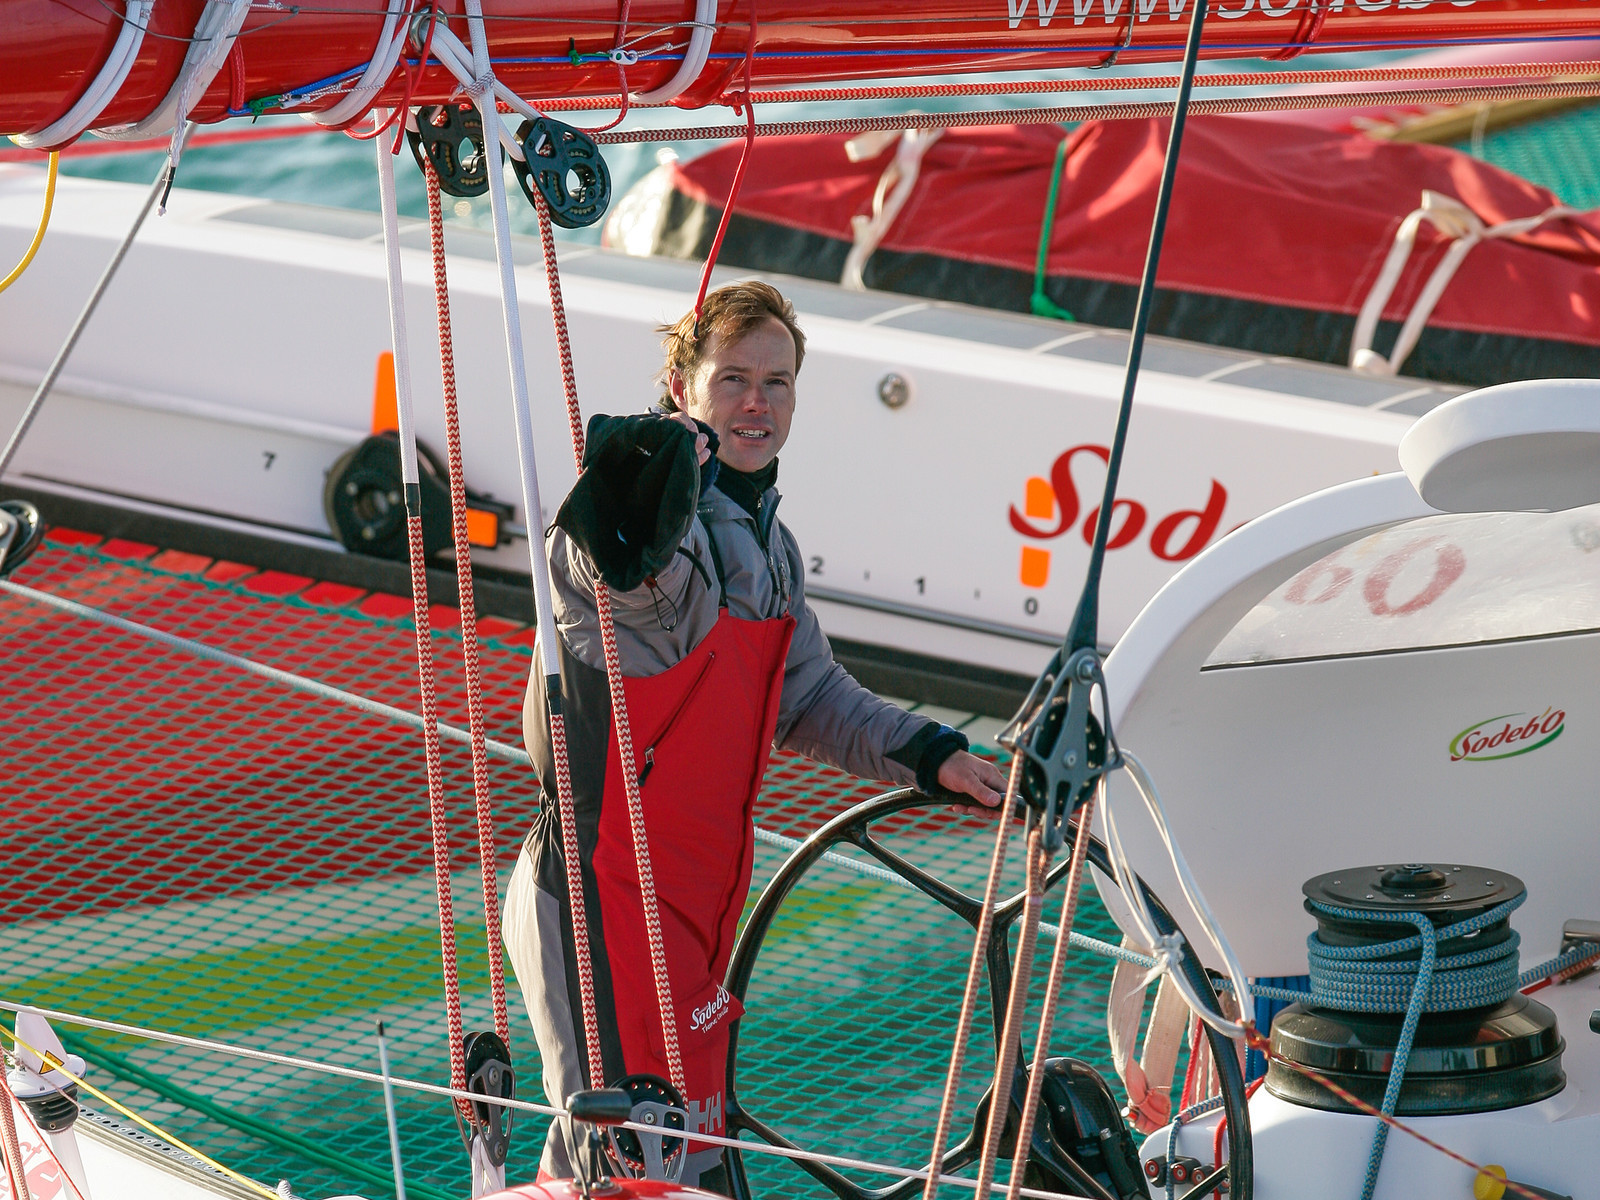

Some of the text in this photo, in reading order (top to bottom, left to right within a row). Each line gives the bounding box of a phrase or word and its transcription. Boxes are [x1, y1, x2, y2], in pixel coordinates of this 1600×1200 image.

[262, 451, 277, 470] 7
[809, 555, 1038, 616] 2 1 0
